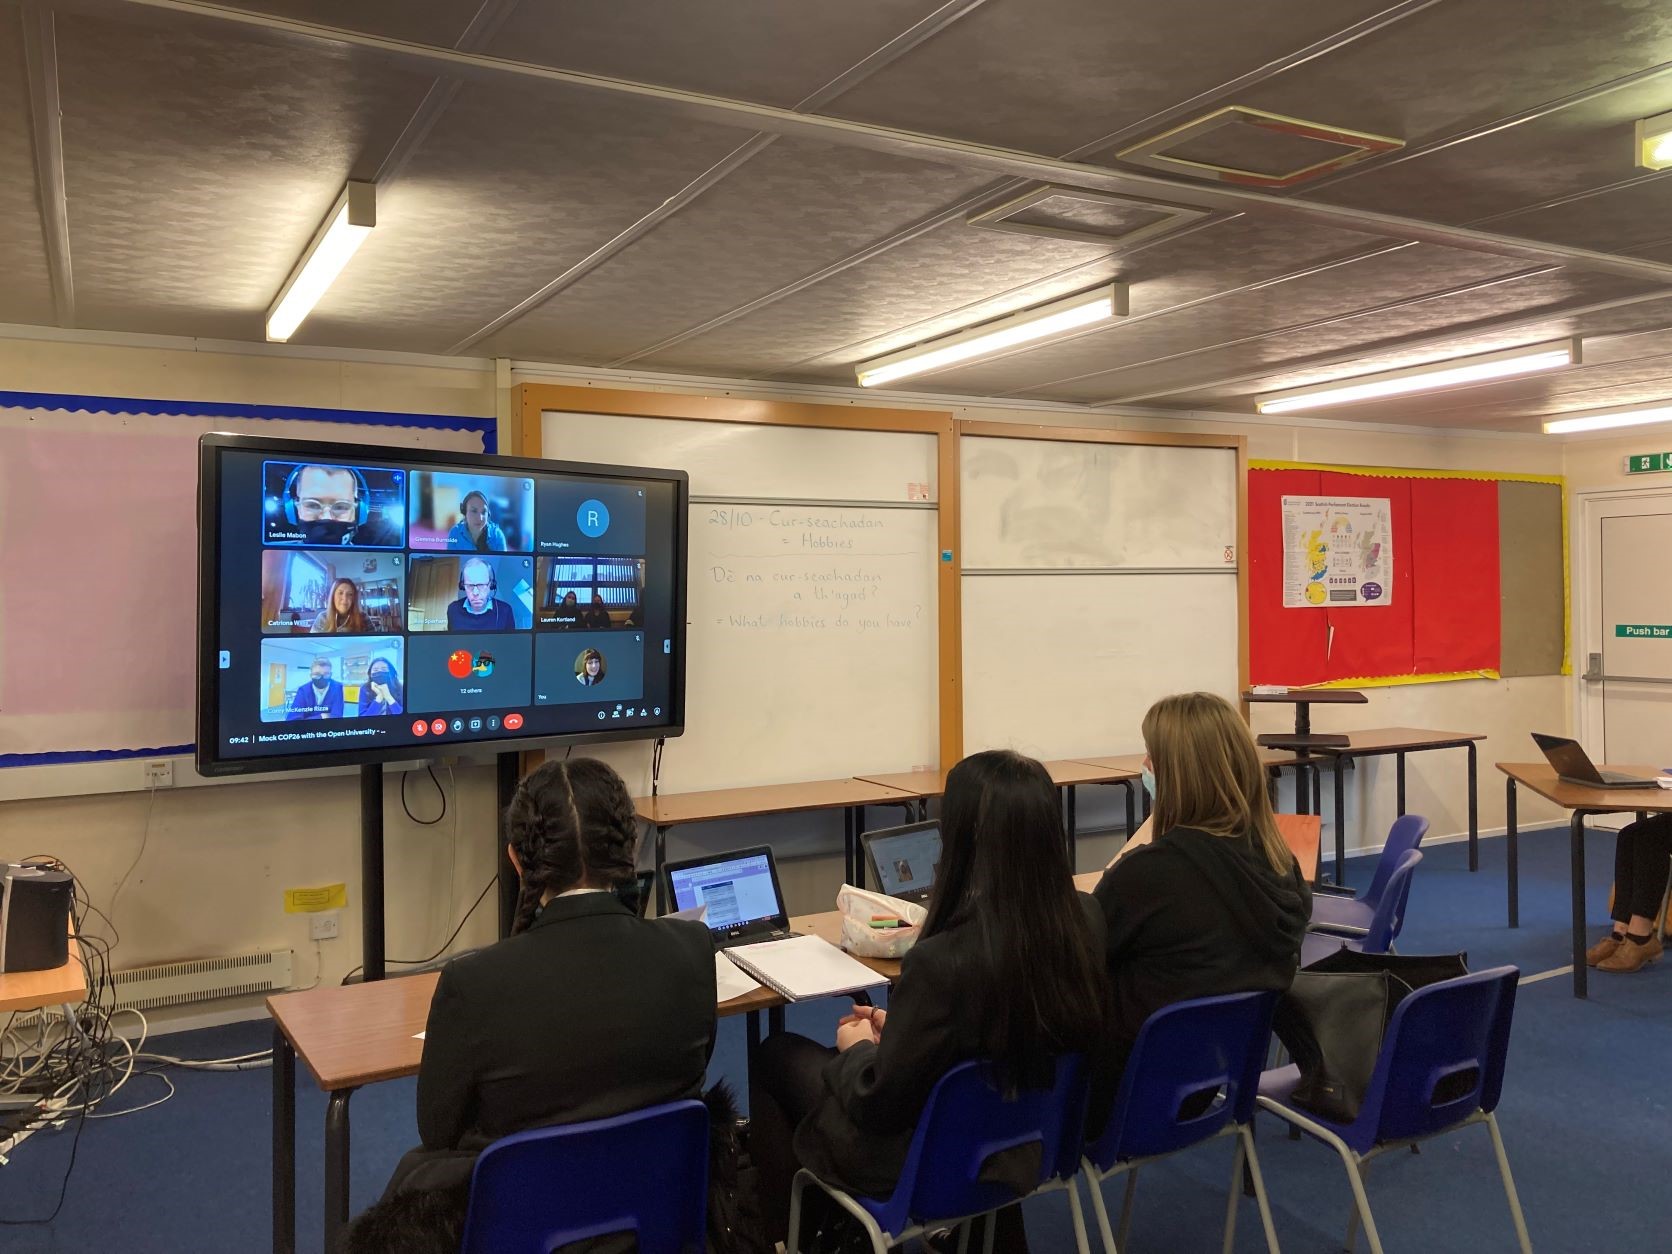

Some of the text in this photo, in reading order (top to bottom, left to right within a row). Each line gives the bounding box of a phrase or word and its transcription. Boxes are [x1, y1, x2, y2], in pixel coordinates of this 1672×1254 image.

[587, 510, 599, 527] R
[708, 508, 753, 530] 28/10
[768, 509, 885, 530] Cur-seachadan
[801, 532, 854, 550] Hobbies
[746, 574, 763, 582] na
[793, 591, 801, 600] a
[729, 616, 767, 628] What
[778, 614, 826, 629] hobbies
[835, 616, 849, 627] do
[856, 618, 881, 634] you
[1626, 626, 1670, 636] Push bar
[229, 736, 249, 744] 09:42
[258, 734, 277, 742] Mock
[277, 733, 301, 741] COP26
[327, 730, 345, 738] Open
[345, 728, 376, 736] University
